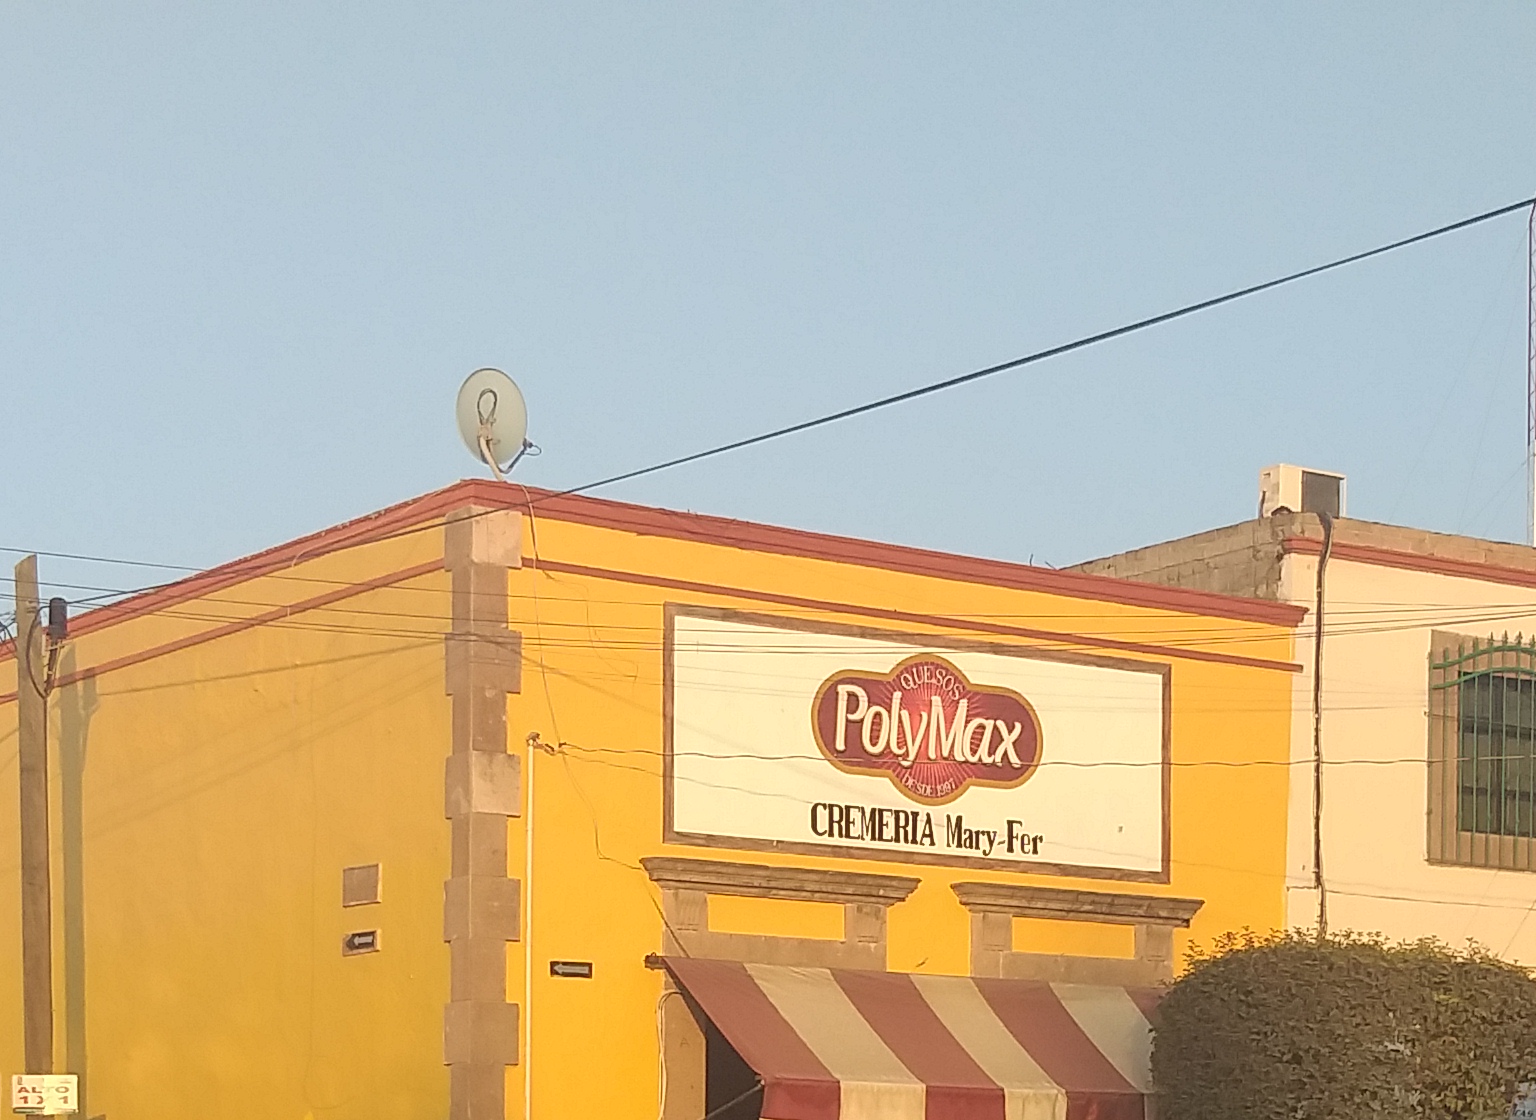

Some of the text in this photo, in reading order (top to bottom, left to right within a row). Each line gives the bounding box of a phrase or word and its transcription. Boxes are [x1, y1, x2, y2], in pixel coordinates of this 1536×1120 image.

[900, 665, 964, 700] QUESOS
[835, 684, 1022, 769] PolyMax
[902, 773, 935, 797] DESDE
[811, 802, 1044, 857] CREMERIA Mary-Fer
[17, 1086, 70, 1094] ALTO
